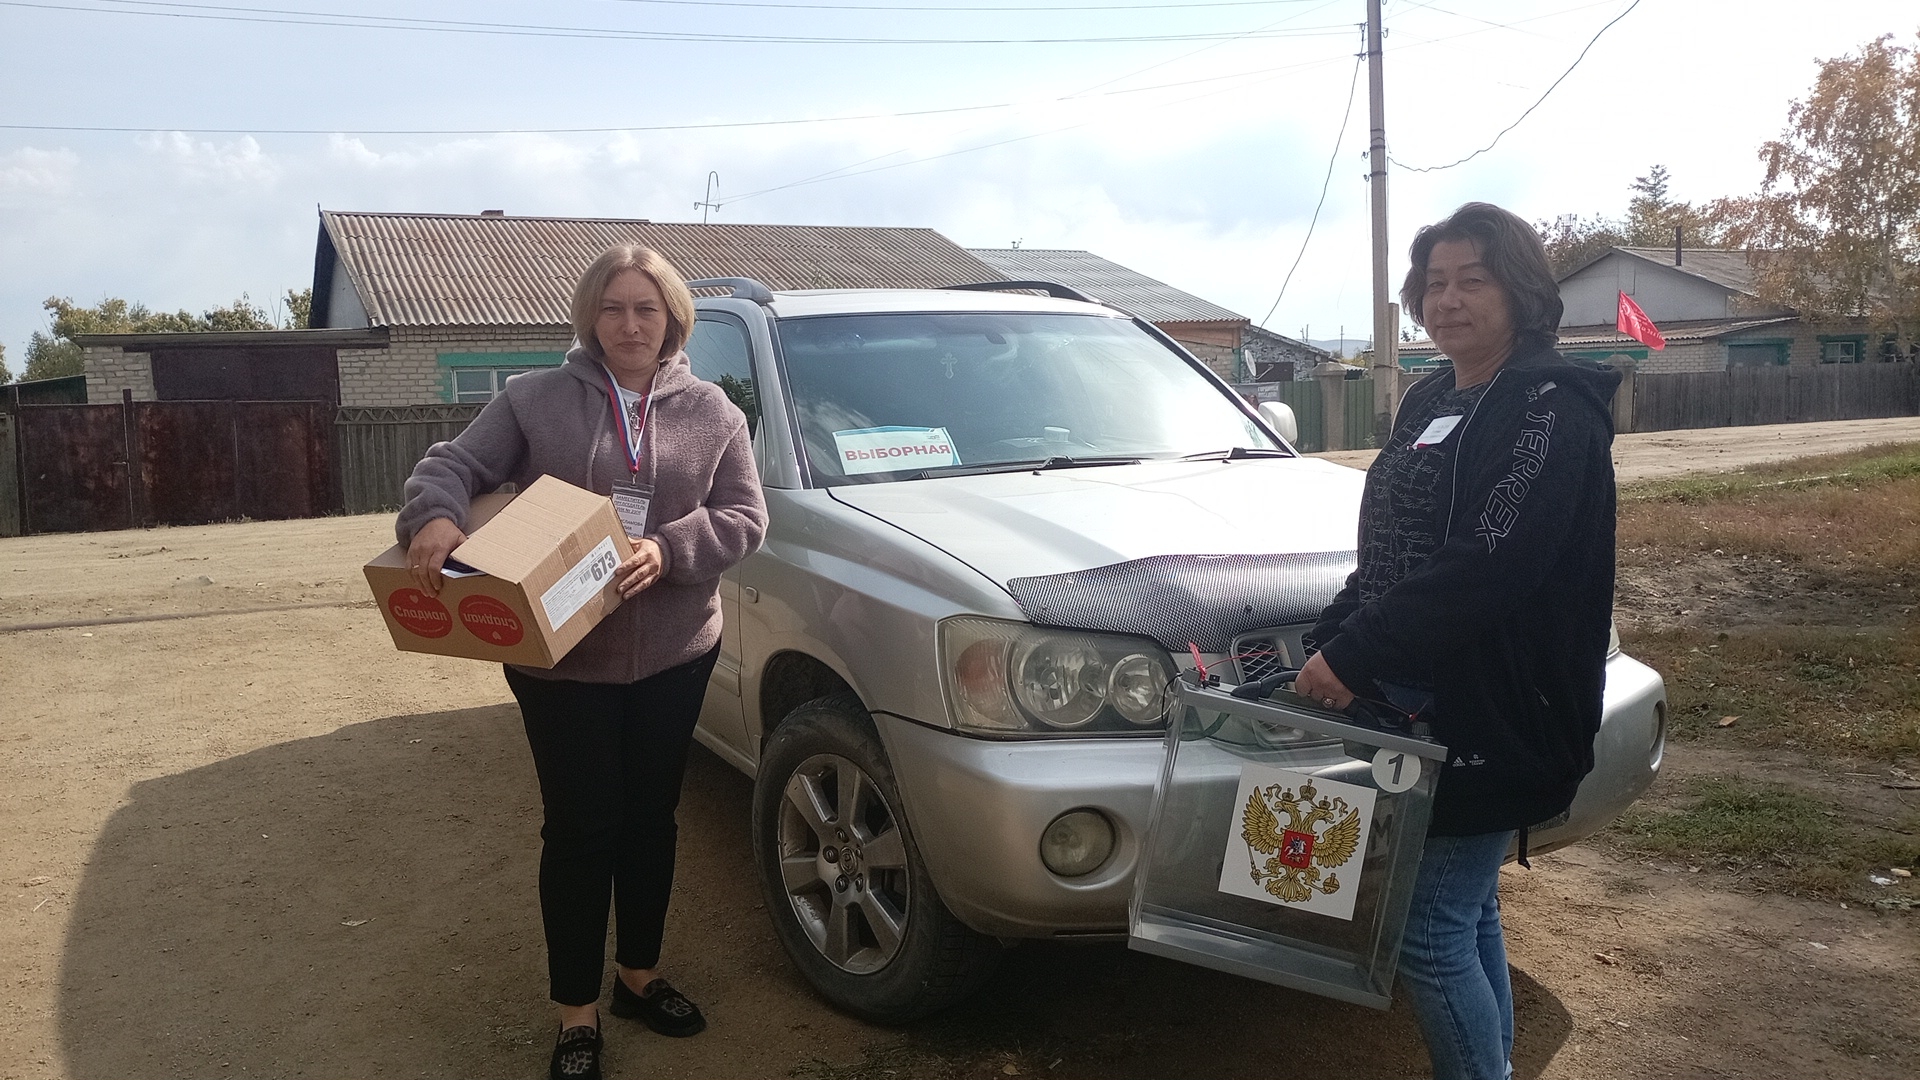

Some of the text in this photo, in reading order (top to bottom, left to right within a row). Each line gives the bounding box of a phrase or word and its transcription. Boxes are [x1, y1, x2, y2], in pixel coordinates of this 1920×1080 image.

[845, 444, 951, 460] ВЫБОРНАЯ
[1475, 411, 1556, 553] TERREX
[590, 550, 617, 581] 673
[1388, 753, 1405, 785] 1
